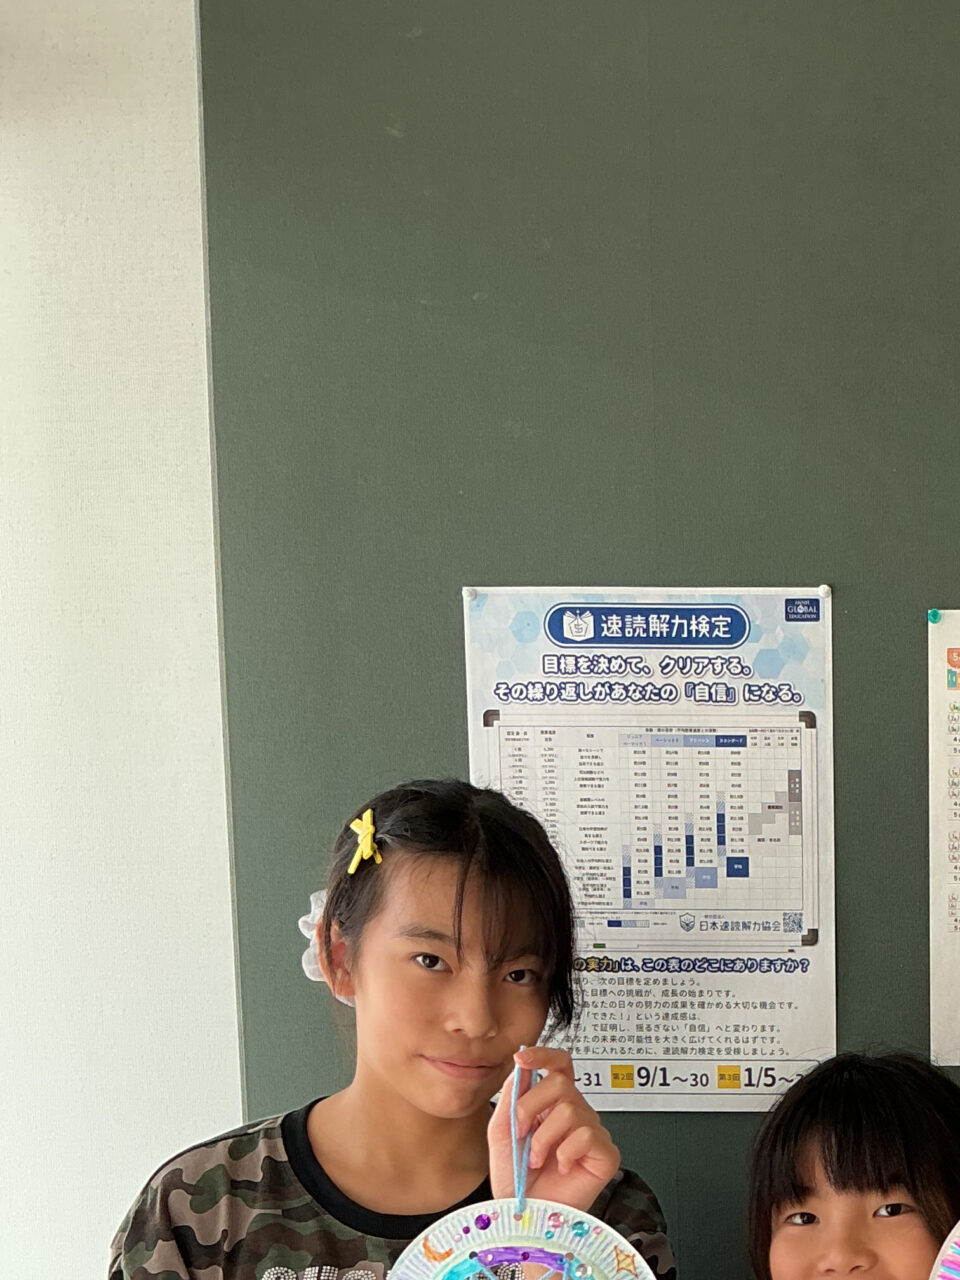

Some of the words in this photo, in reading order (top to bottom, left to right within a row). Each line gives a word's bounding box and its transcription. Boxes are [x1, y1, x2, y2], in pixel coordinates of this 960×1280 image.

[787, 605, 817, 613] GLOBAL
[600, 613, 732, 639] 速読解力検定
[542, 654, 752, 677] 目標を決めて、クリアする。
[493, 682, 805, 705] その繰り返しがあなたの『自信』になる。
